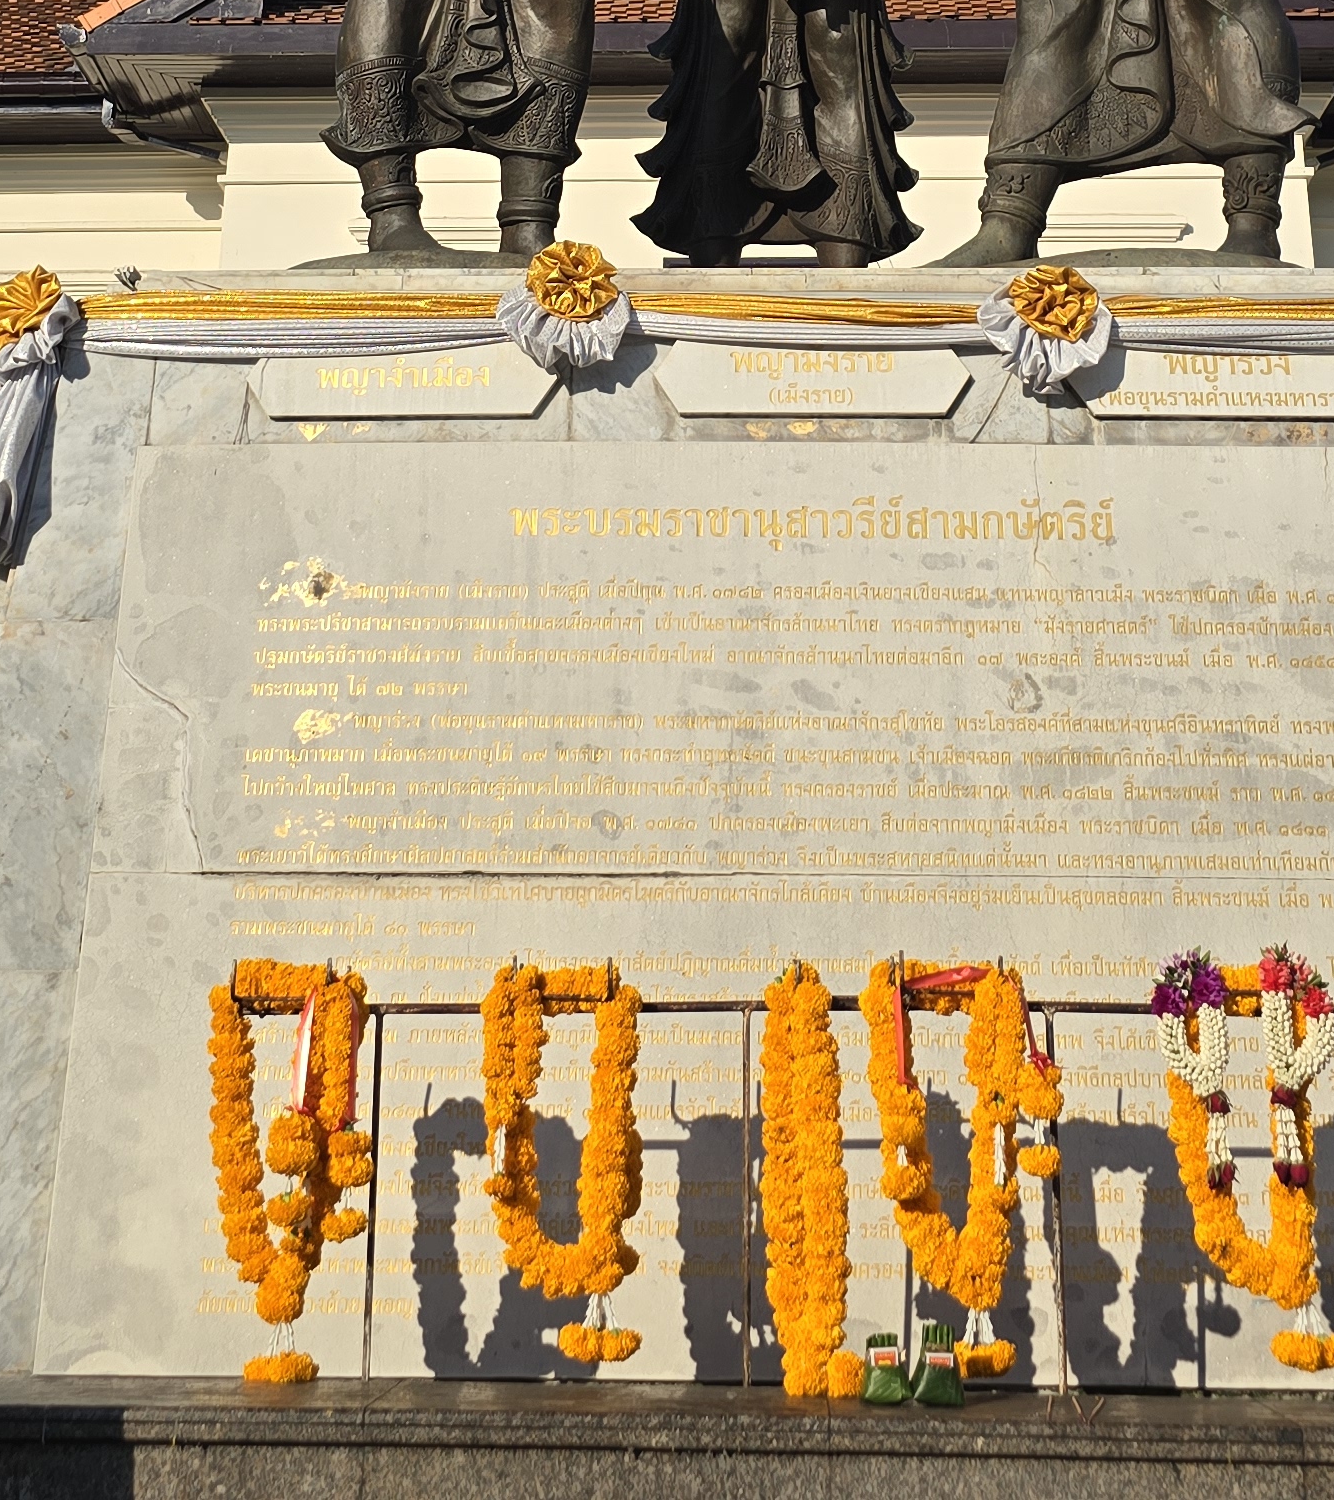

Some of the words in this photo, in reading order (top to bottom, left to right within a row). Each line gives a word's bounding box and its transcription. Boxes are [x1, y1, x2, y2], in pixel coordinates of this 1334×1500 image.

[316, 356, 490, 394] พญางำเมือง
[730, 350, 894, 380] พญามงราย
[1165, 354, 1291, 382] พญารวง
[768, 383, 854, 406] (เม็งราย)
[510, 496, 1114, 552] พระบรมราชานุสาวรีย์สามกษัตริย์
[538, 580, 589, 604] ประสูติ
[674, 583, 707, 599] พ.ศ.
[1143, 586, 1239, 604] พระราชบิดา
[1247, 582, 1277, 604] เมื่อ
[1286, 590, 1319, 604] พ.ศ.
[1017, 647, 1081, 667] พระองค์
[1094, 641, 1190, 668] สิ้นพระชนม์
[1203, 644, 1234, 668] เมื่อ
[1247, 654, 1281, 669] พ.ศ.
[252, 680, 338, 700] พระชนมายุ
[348, 675, 367, 696] ได้
[414, 681, 467, 696] พรรษา
[557, 747, 611, 763] พรรษา
[1021, 783, 1056, 800] พ.ศ.
[1123, 774, 1220, 802] สิ้นพระชนม์
[1232, 787, 1260, 802] ราว
[1271, 786, 1307, 802] พ.ศ.
[603, 814, 637, 830] พ.ศ.
[1081, 814, 1180, 836] พระราชบิดา
[1192, 810, 1224, 836] เมื่อ
[1235, 820, 1271, 836] พ.ศ.
[1173, 880, 1270, 908] สิ้นพระชนม์
[1279, 882, 1310, 908] เมื่อ
[418, 919, 476, 937] พรรษา
